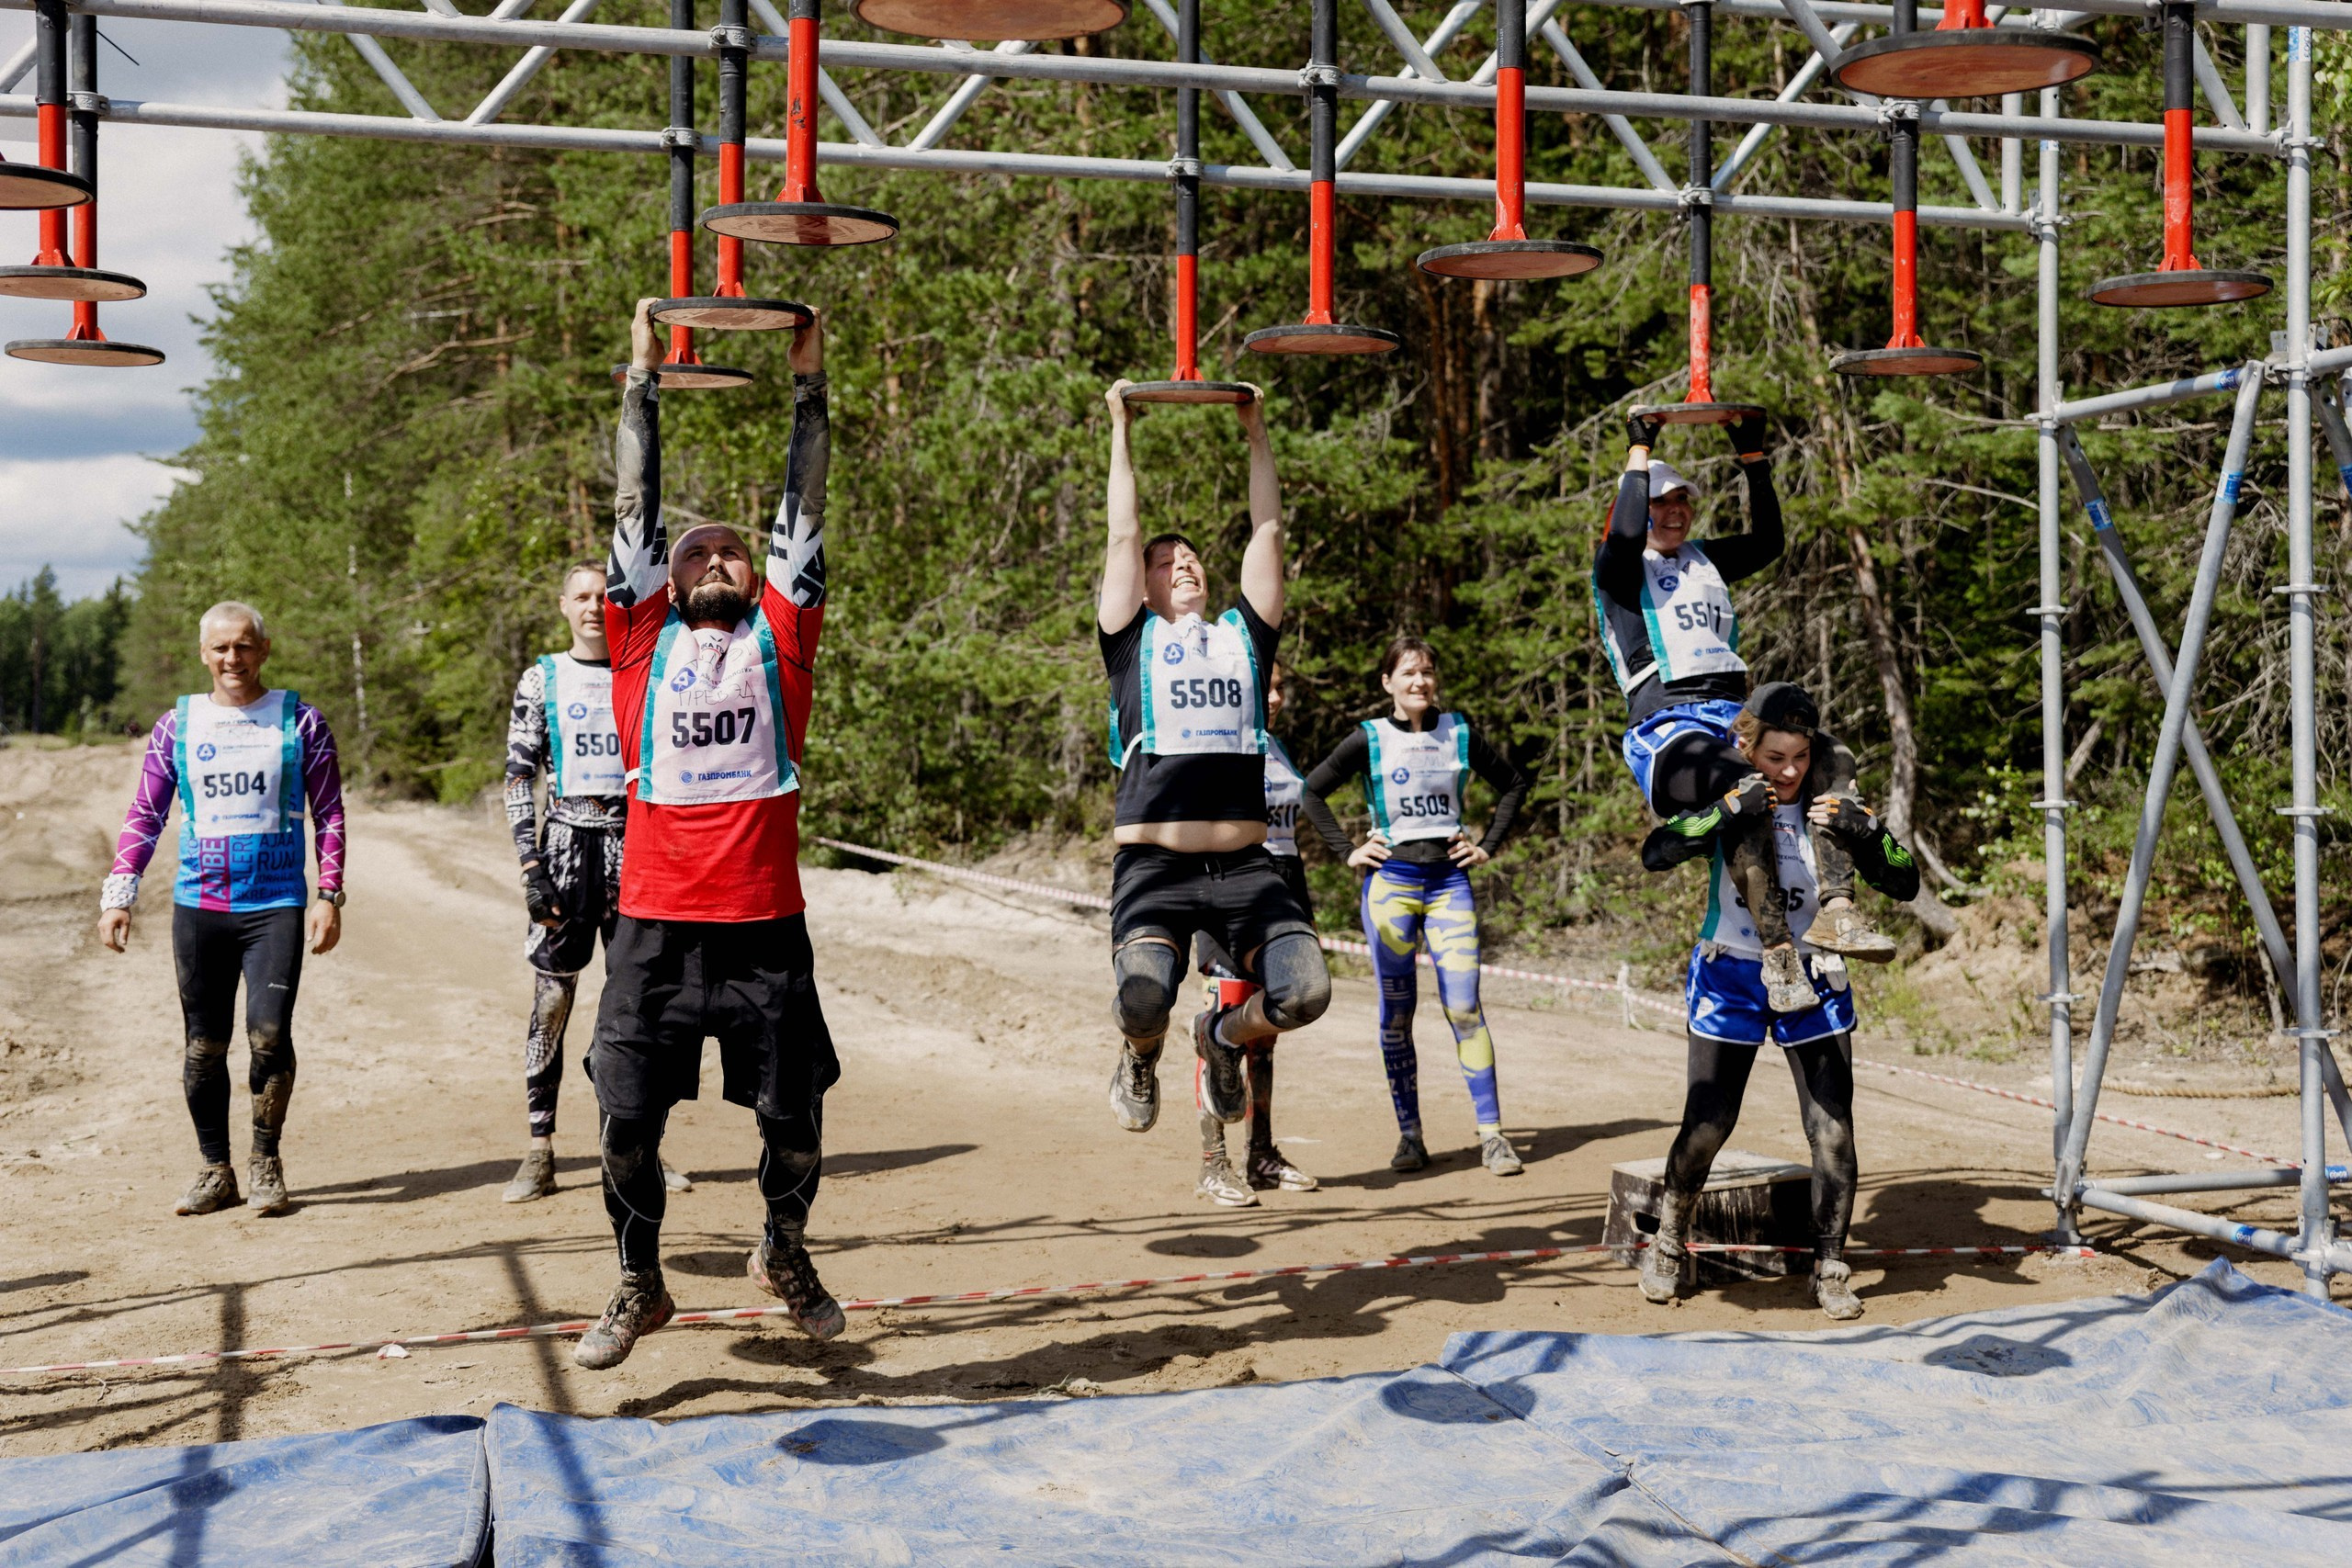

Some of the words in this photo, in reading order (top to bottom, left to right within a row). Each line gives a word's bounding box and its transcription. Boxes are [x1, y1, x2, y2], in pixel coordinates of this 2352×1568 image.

[1170, 678, 1241, 709] 5508
[673, 706, 756, 748] 5507
[575, 732, 620, 757] 550
[204, 771, 266, 798] 5504
[698, 770, 752, 781] ГАЗПРОМБАНК
[1400, 794, 1449, 817] 5509
[201, 837, 227, 900] AMBE
[257, 851, 295, 872] RUN
